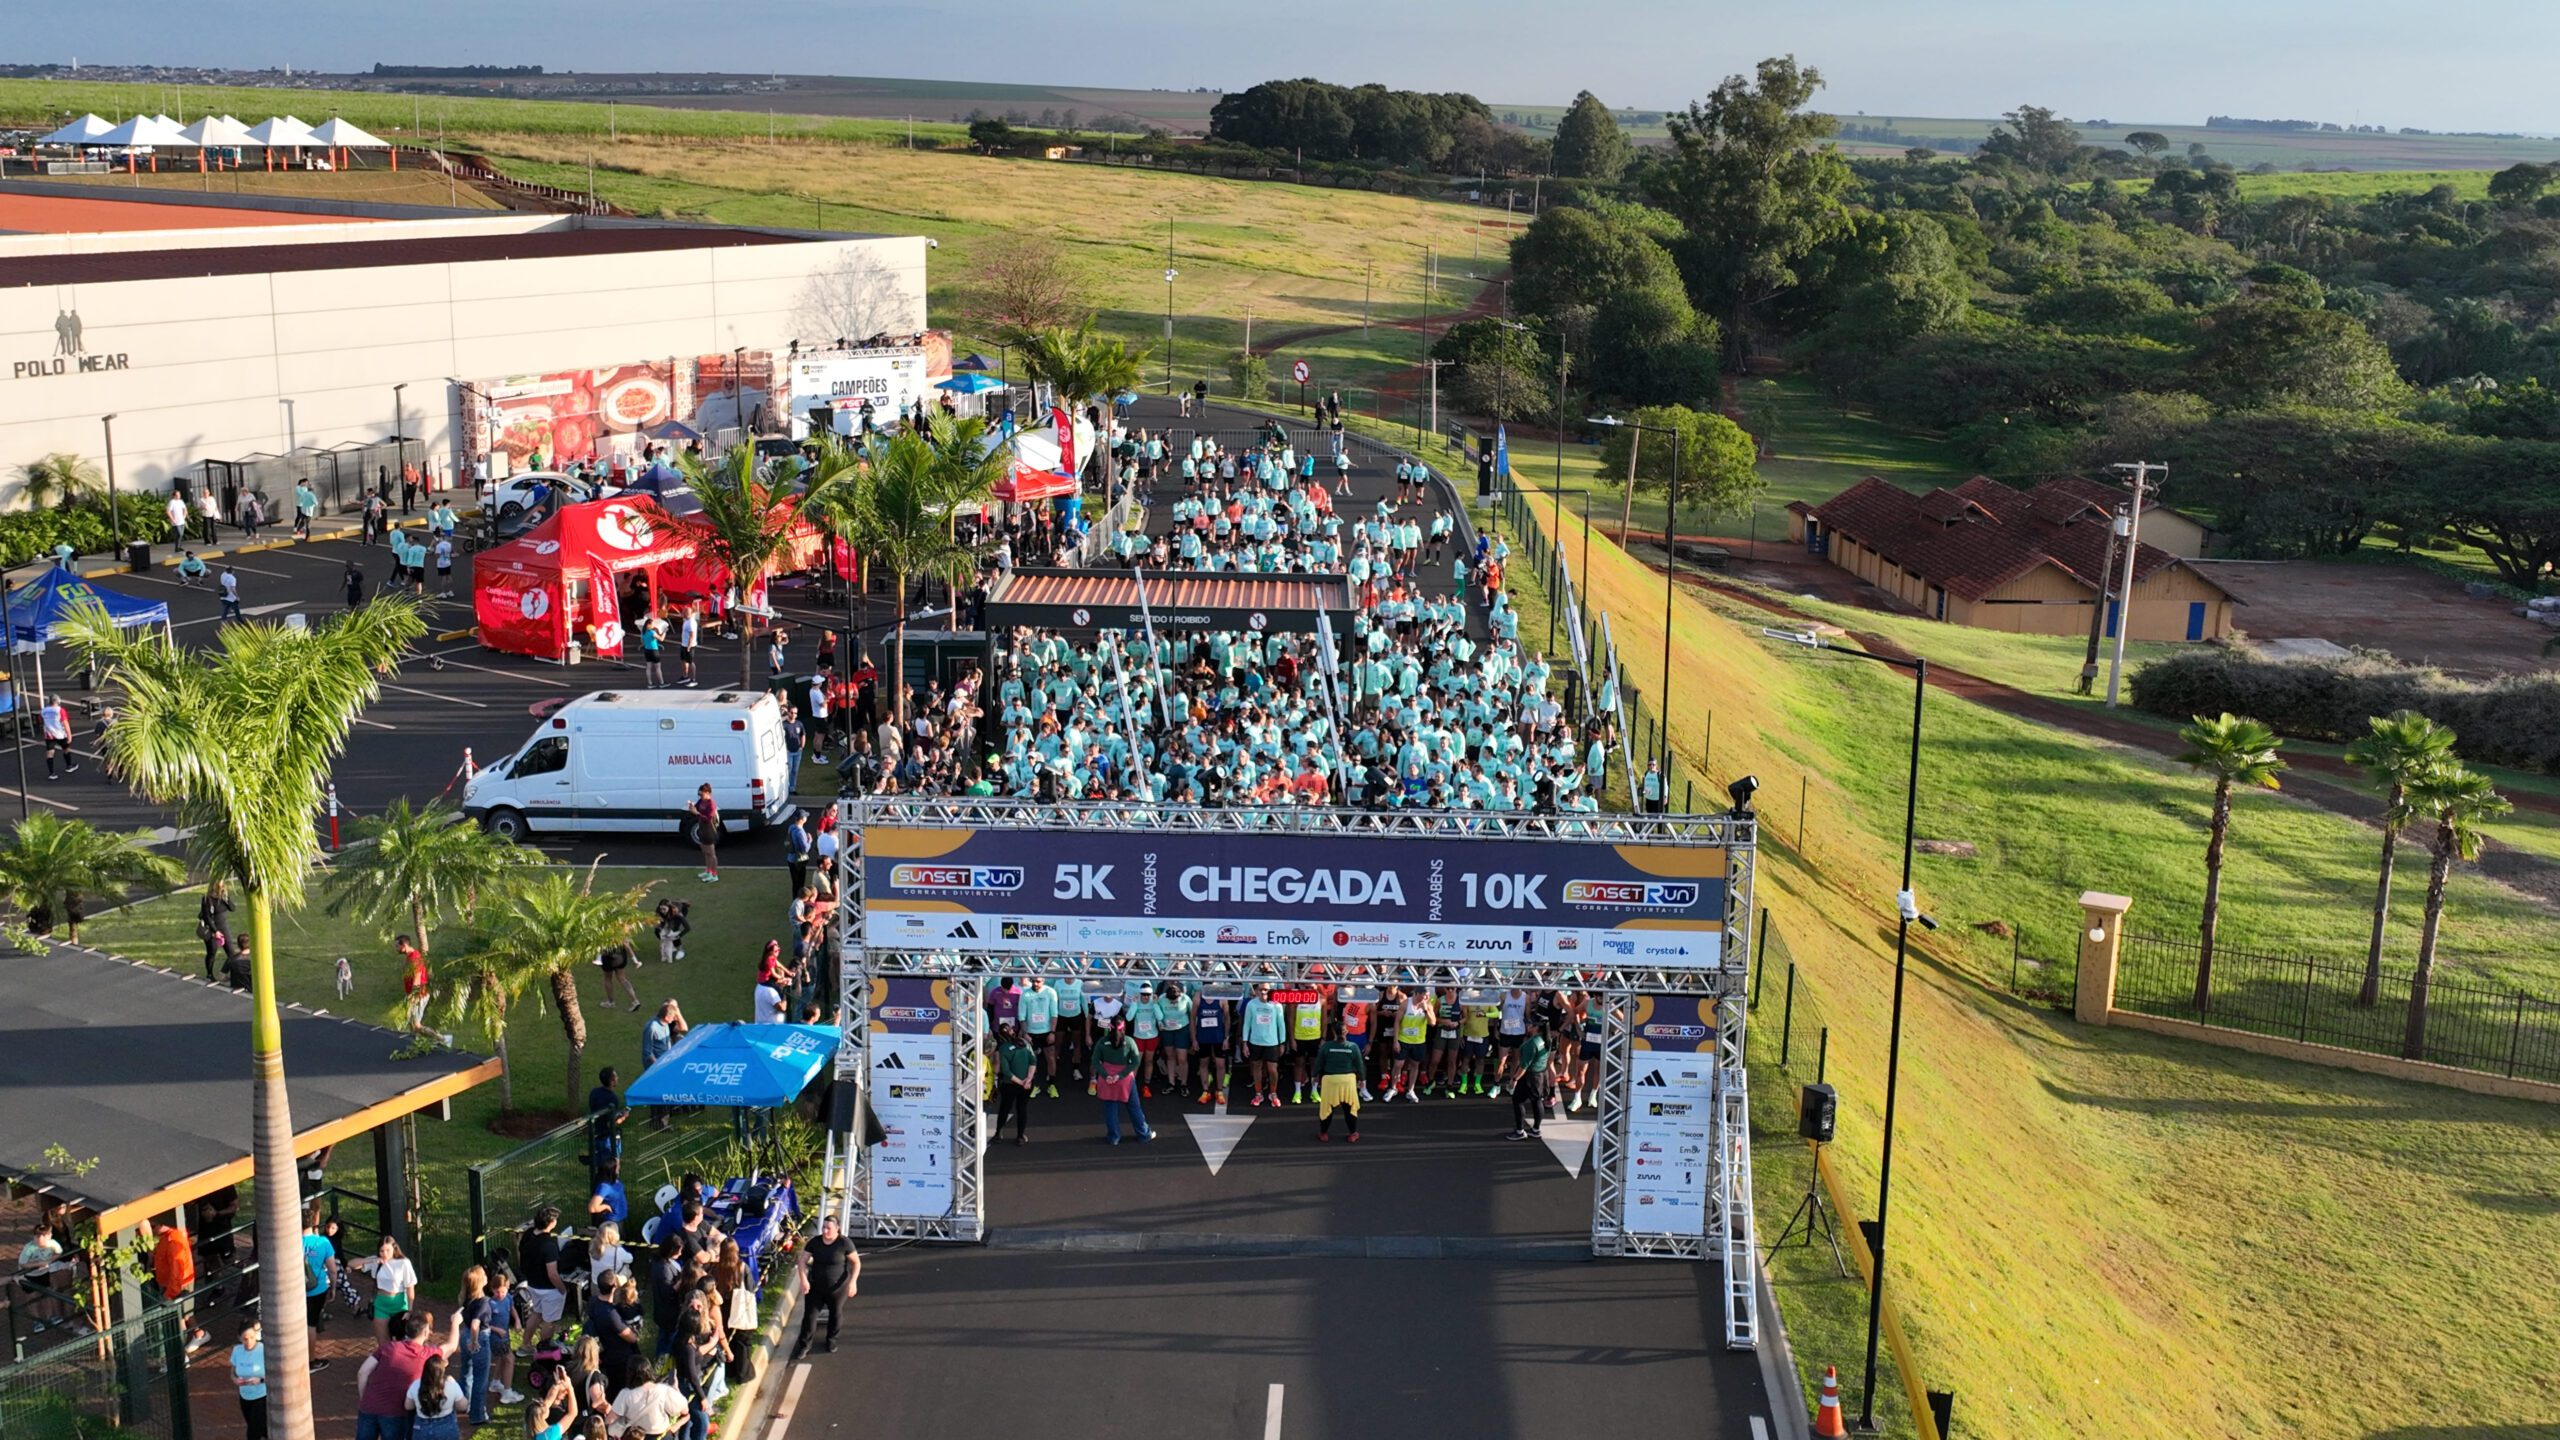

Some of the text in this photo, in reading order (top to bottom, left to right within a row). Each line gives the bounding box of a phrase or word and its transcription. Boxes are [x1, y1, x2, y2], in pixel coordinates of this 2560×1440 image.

[14, 353, 129, 378] POLO WEAR
[831, 375, 887, 396] CAMPEÕES
[668, 753, 732, 765] AMBULÂNCIA
[1053, 864, 1115, 900] 5K
[1144, 853, 1157, 915] PARABÉNS
[1179, 865, 1406, 906] CHEGADA
[1427, 859, 1443, 921] PARABÉNS
[1460, 873, 1547, 909] 10K
[1165, 929, 1205, 938] SICOOB
[1268, 931, 1310, 945] Emov
[1350, 933, 1389, 943] nakashi
[1399, 939, 1456, 949] STECAR
[1603, 940, 1635, 948] POWER
[1645, 947, 1677, 956] crystal
[682, 1063, 747, 1074] POWER
[704, 1074, 742, 1085] ADE
[662, 1093, 696, 1103] PAUSA
[706, 1094, 744, 1104] POWER
